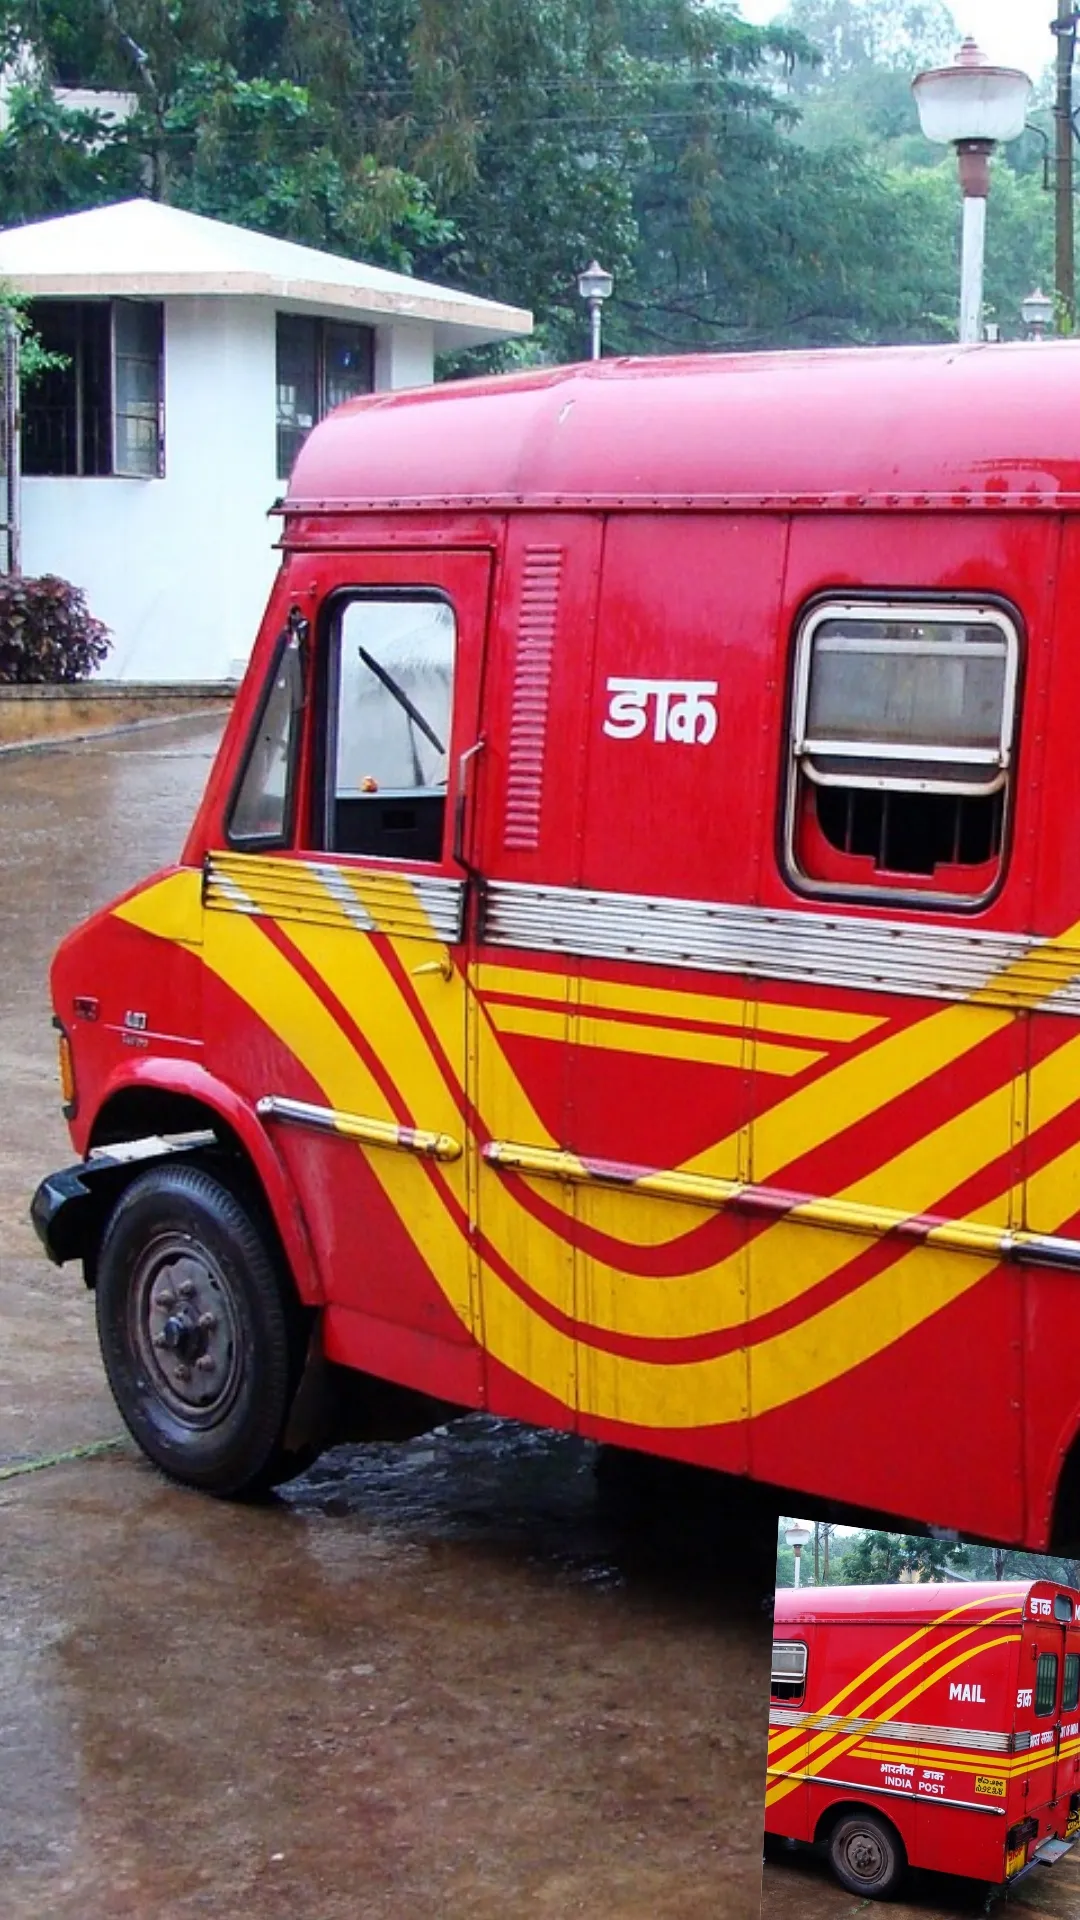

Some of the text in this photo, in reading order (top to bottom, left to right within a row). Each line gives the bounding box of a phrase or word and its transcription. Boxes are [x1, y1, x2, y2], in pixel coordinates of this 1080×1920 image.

[602, 677, 719, 745] डाक
[1030, 1597, 1052, 1616] डाक
[949, 1682, 986, 1703] MAIL
[1016, 1689, 1033, 1708] डाक
[880, 1763, 945, 1781] भारतीय डाक
[884, 1775, 945, 1795] INDIA POST
